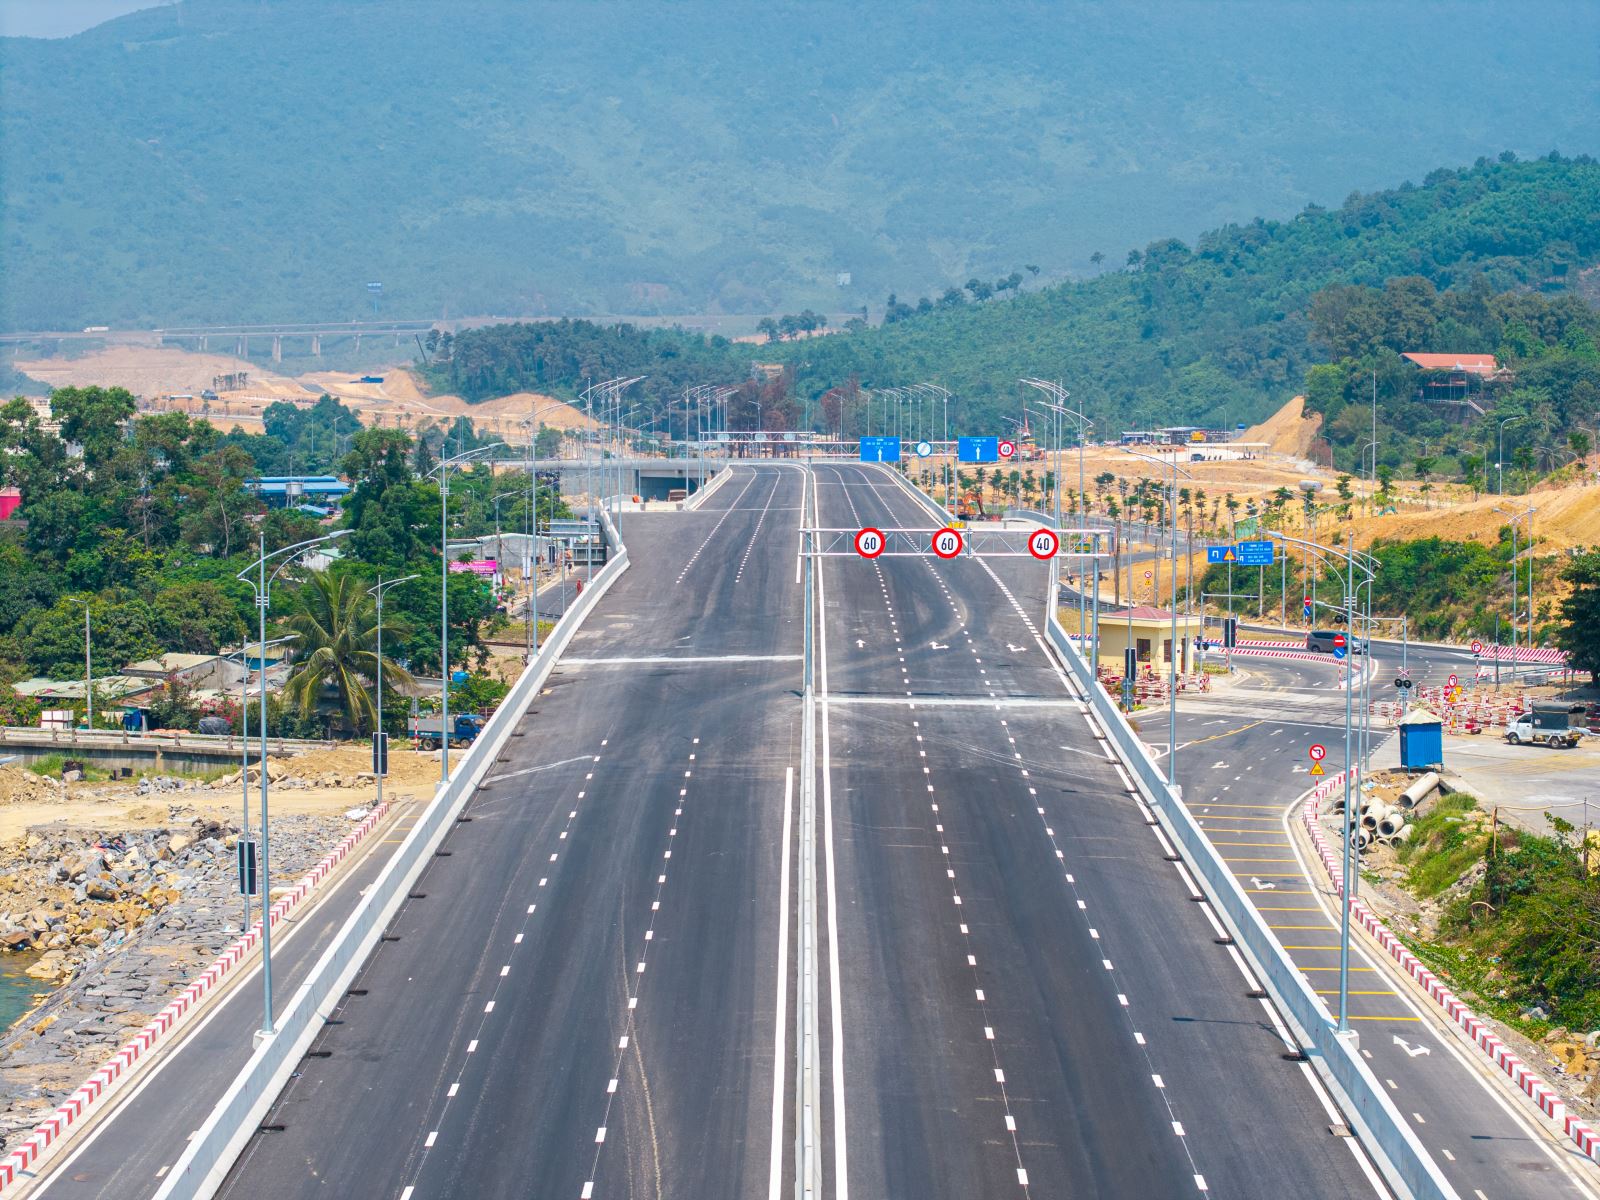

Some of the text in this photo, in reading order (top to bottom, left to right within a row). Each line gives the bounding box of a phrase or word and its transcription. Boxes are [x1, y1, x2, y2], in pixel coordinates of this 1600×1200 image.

[864, 537, 876, 550] 60
[941, 538, 954, 551] 60
[1036, 538, 1050, 551] 40
